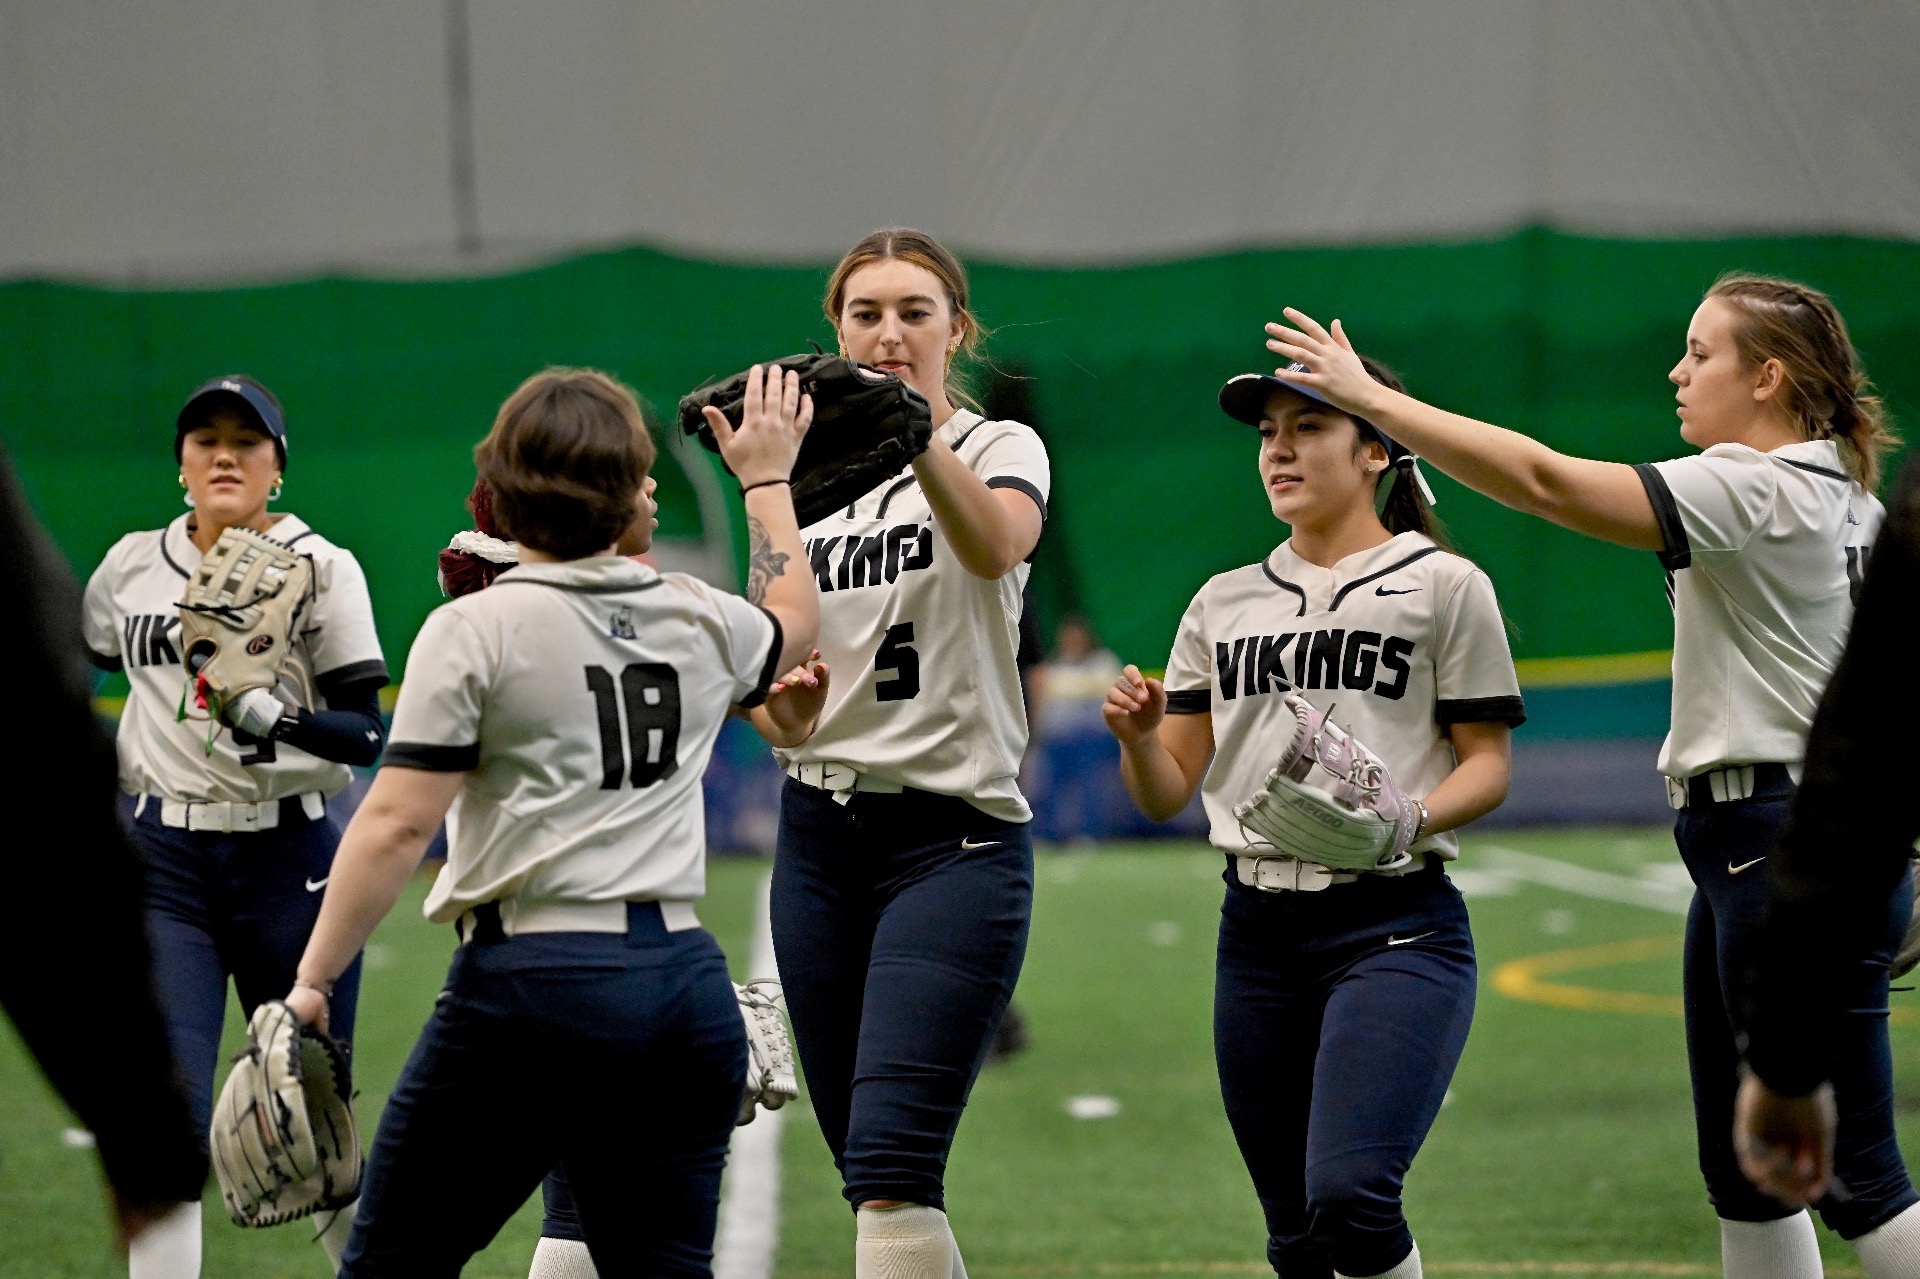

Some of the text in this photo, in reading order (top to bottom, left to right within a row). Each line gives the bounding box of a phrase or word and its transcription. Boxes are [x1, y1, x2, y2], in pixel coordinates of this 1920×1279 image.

[874, 621, 921, 702] 5
[1216, 628, 1416, 701] VIKINGS
[584, 662, 681, 790] 18
